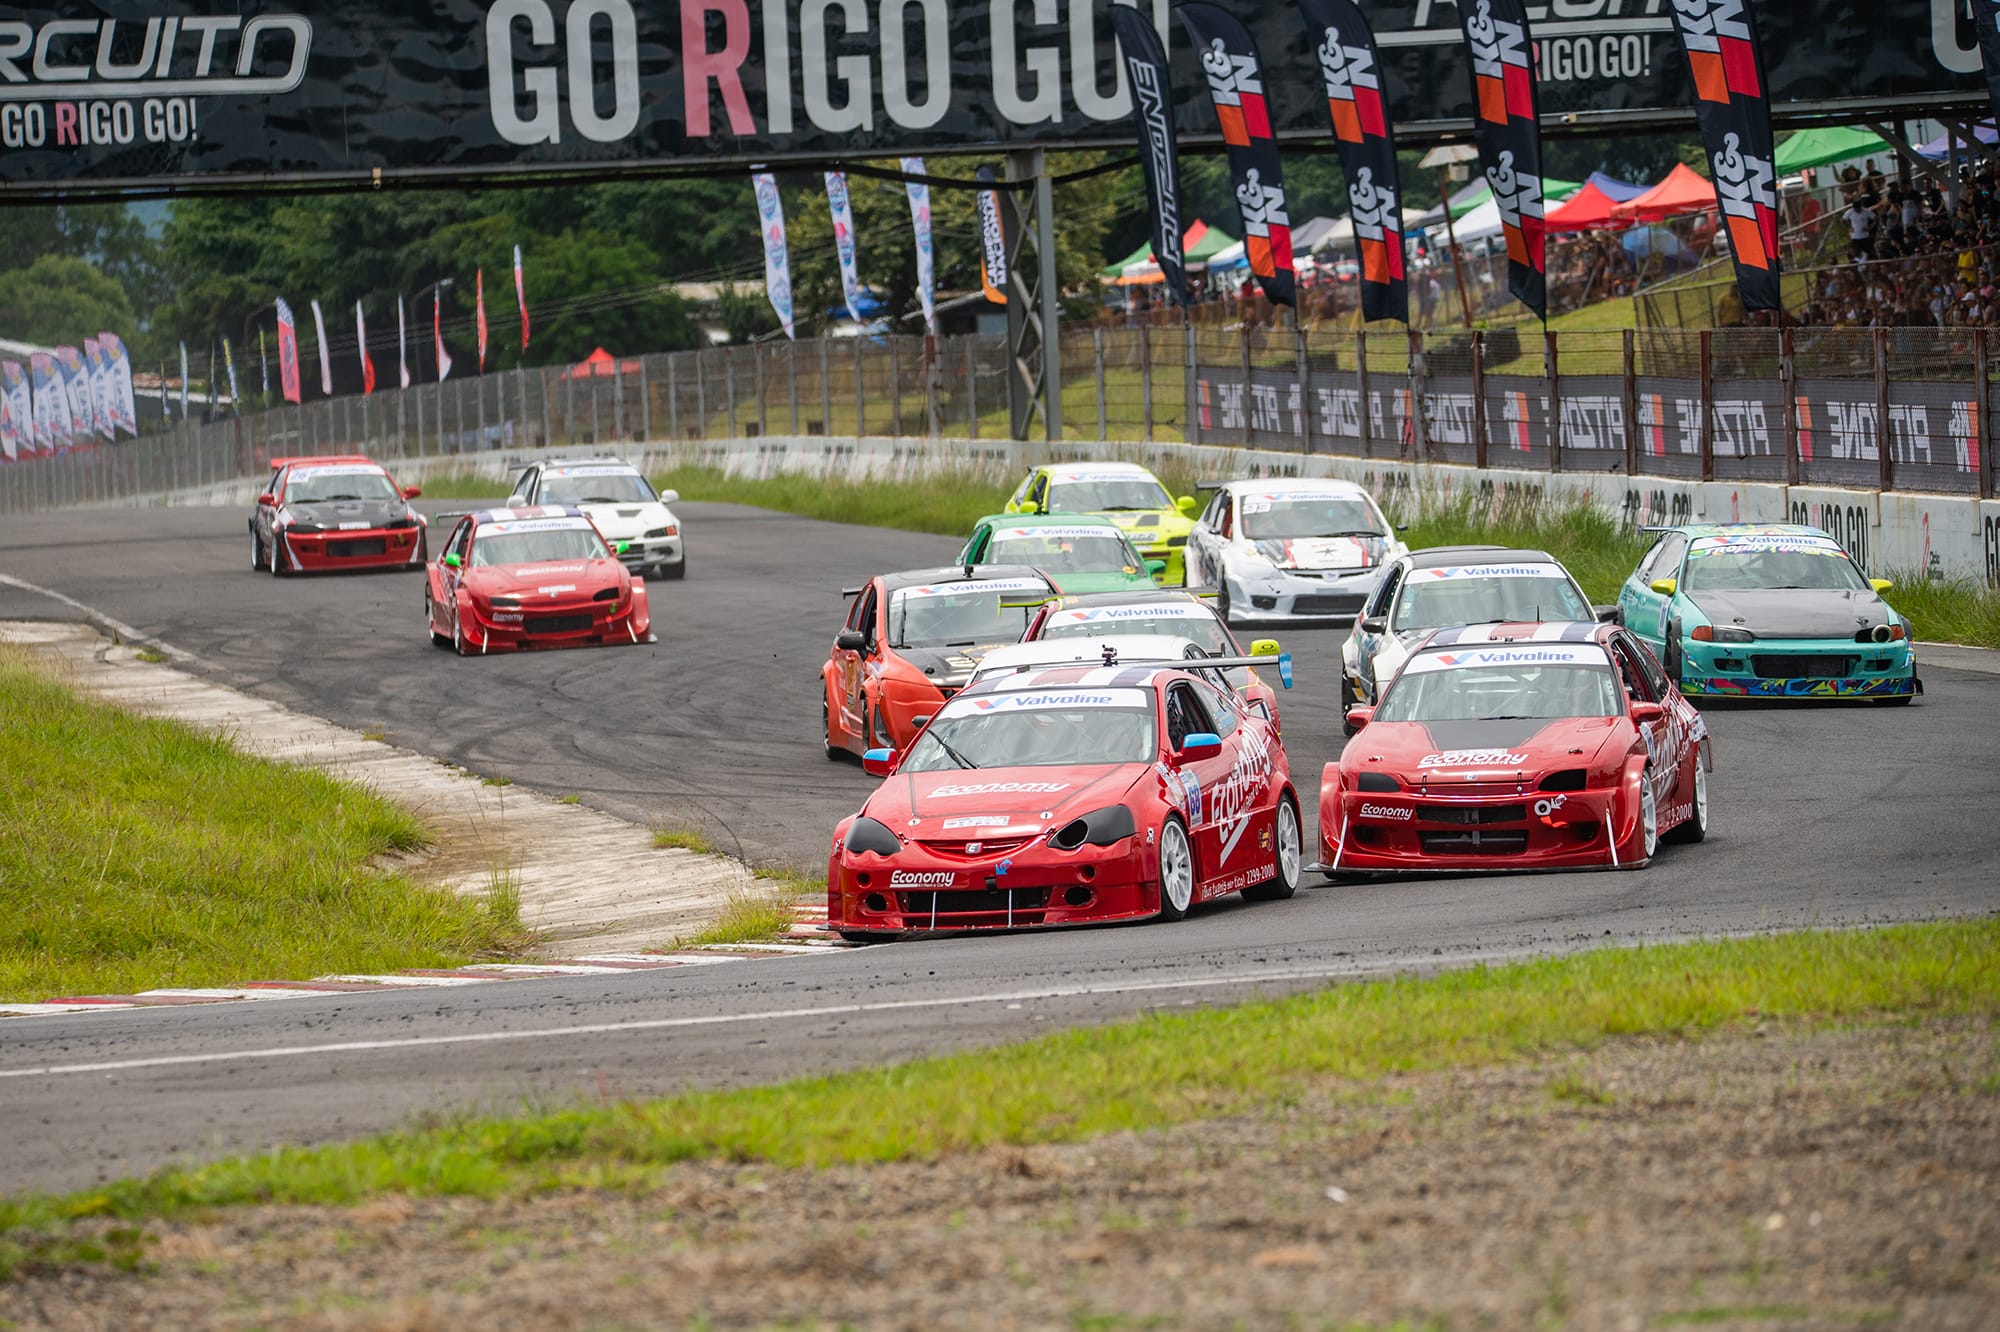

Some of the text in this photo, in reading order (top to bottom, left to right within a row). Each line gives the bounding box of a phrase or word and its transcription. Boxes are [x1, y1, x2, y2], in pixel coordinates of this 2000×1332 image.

[1318, 27, 1379, 100] K&N
[1599, 34, 1650, 79] GO!
[485, 0, 640, 144] GO
[680, 0, 950, 137] RIGO
[1203, 38, 1262, 106] K&N
[2, 97, 198, 147] GO RIGO GO!
[1714, 132, 1776, 219] K&N
[1486, 150, 1544, 228] K&N
[1236, 168, 1290, 238] K&N
[1349, 167, 1397, 242] K&N
[1745, 536, 1818, 545] Valvoline
[1463, 567, 1541, 576] Valvoline
[949, 583, 1023, 592] Valvoline
[1105, 607, 1185, 618] Valvoline
[1479, 651, 1575, 663] Valvoline
[1015, 694, 1113, 706] Valvoline
[1418, 752, 1529, 766] Economy
[929, 782, 1070, 796] Economy
[1361, 802, 1413, 820] Economy
[891, 869, 955, 887] Economy
